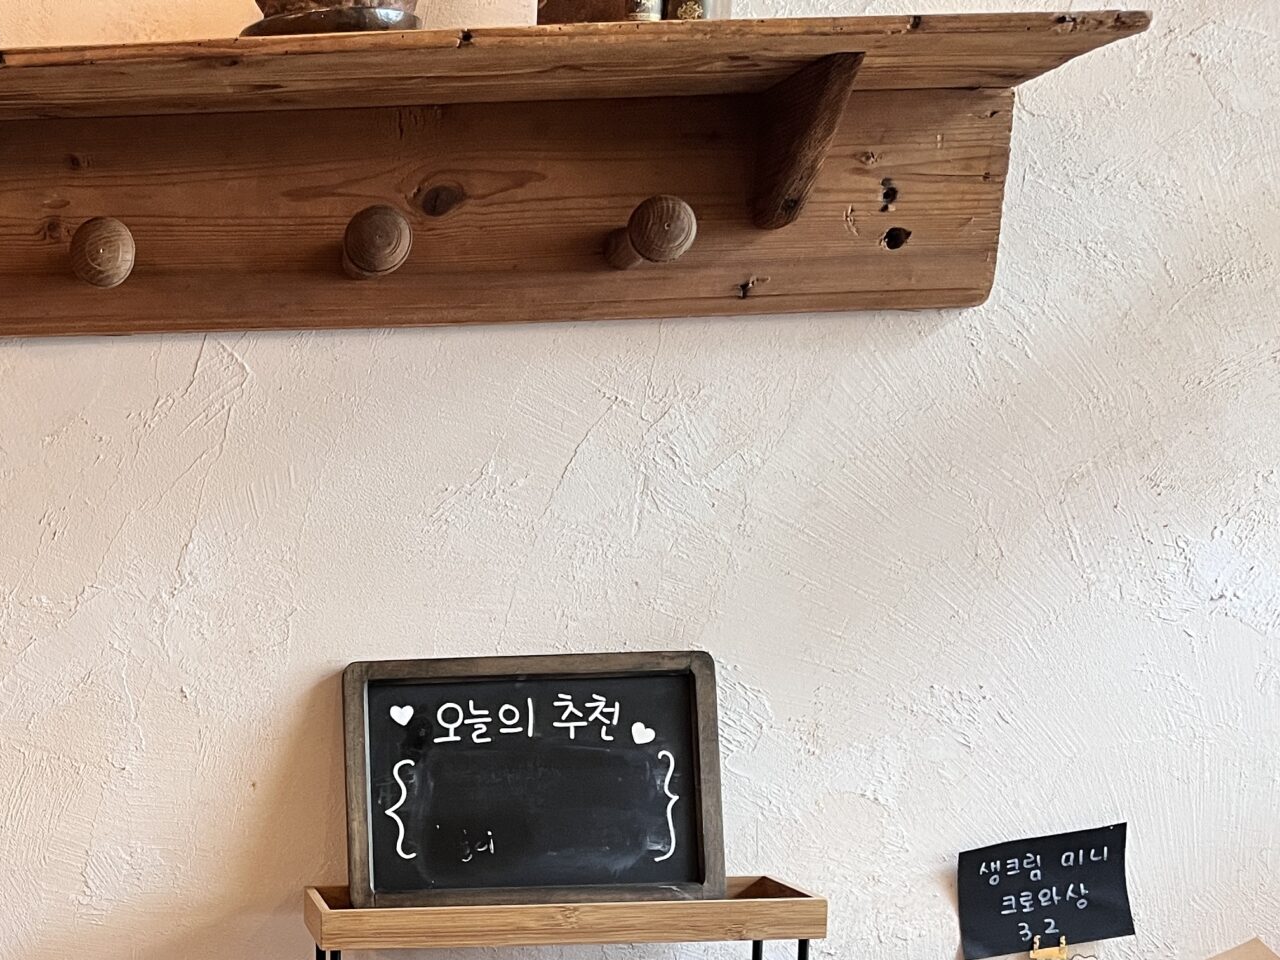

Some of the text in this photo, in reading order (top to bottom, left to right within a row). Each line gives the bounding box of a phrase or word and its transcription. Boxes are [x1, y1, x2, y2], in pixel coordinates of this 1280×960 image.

[433, 693, 620, 744] 오늘의 추천
[979, 846, 1108, 885] 생크림 미니
[1001, 883, 1089, 914] 크로와상
